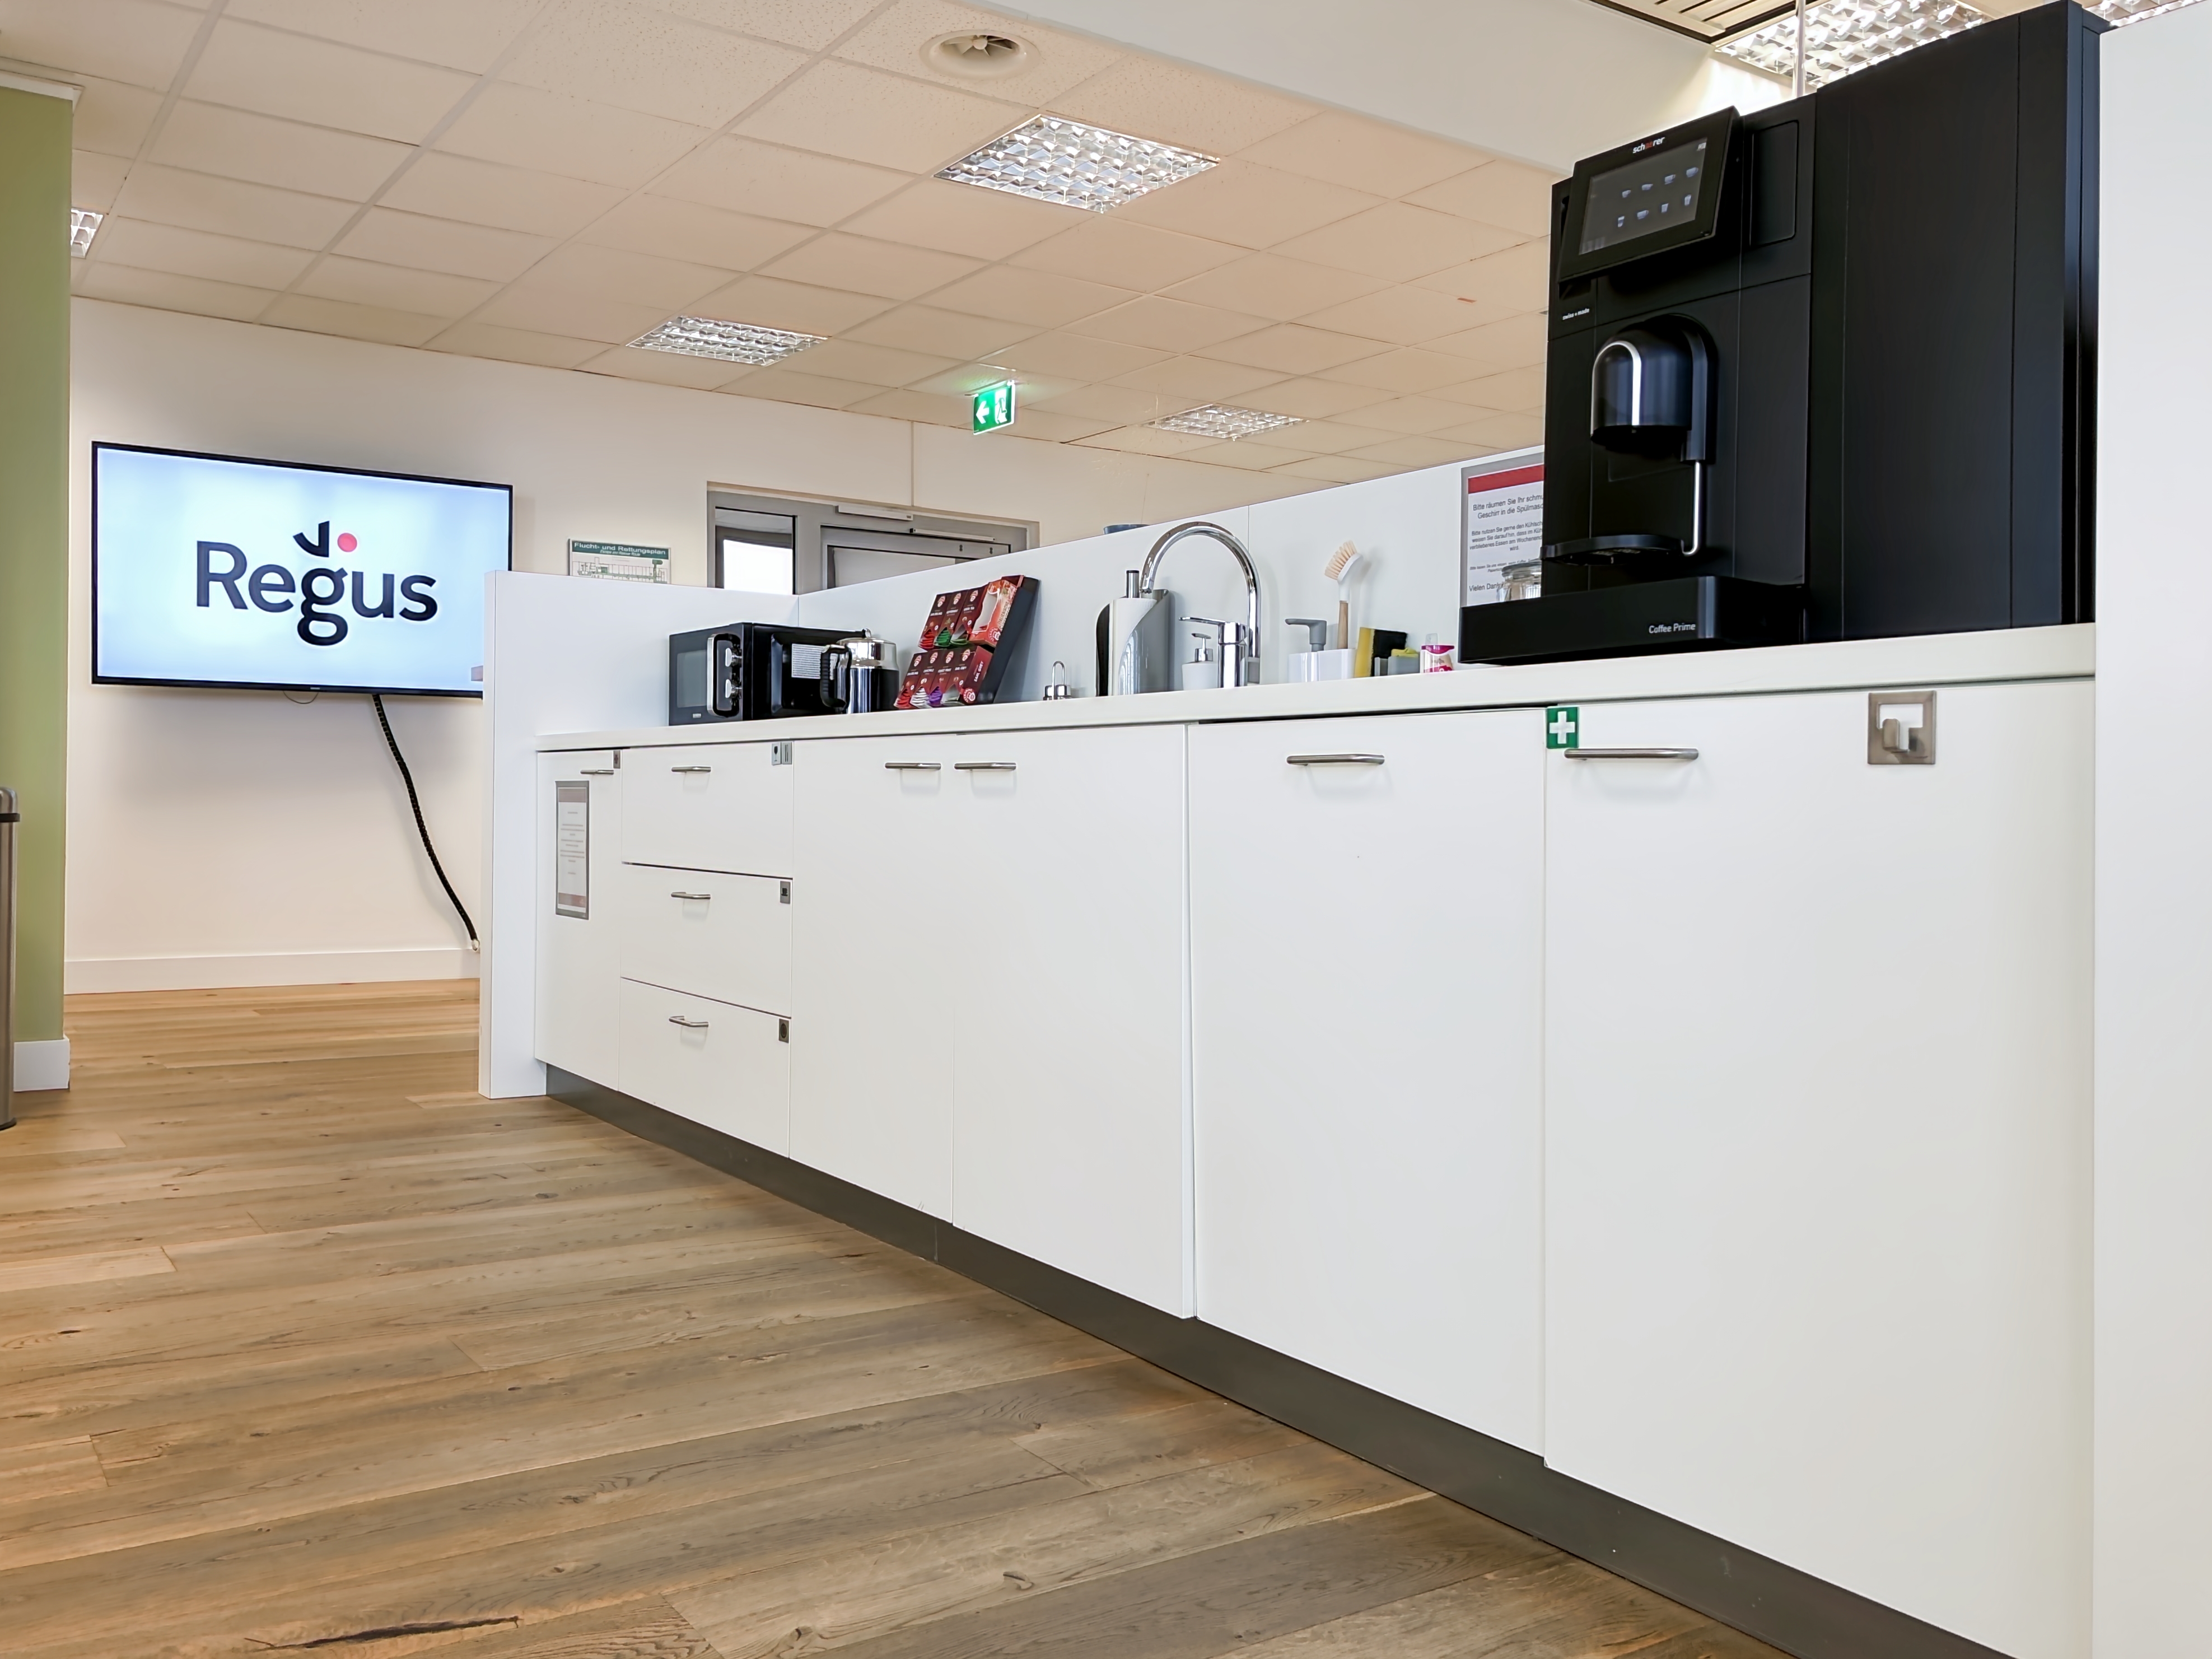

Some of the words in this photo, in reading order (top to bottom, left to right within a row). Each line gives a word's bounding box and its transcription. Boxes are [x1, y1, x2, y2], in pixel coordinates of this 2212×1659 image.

[1486, 500, 1506, 509] räumen
[1478, 510, 1500, 519] Geschirr
[618, 546, 666, 556] Rettungsplan
[197, 540, 438, 646] Regus
[1649, 624, 1672, 633] Coffee
[1673, 623, 1696, 631] Prime
